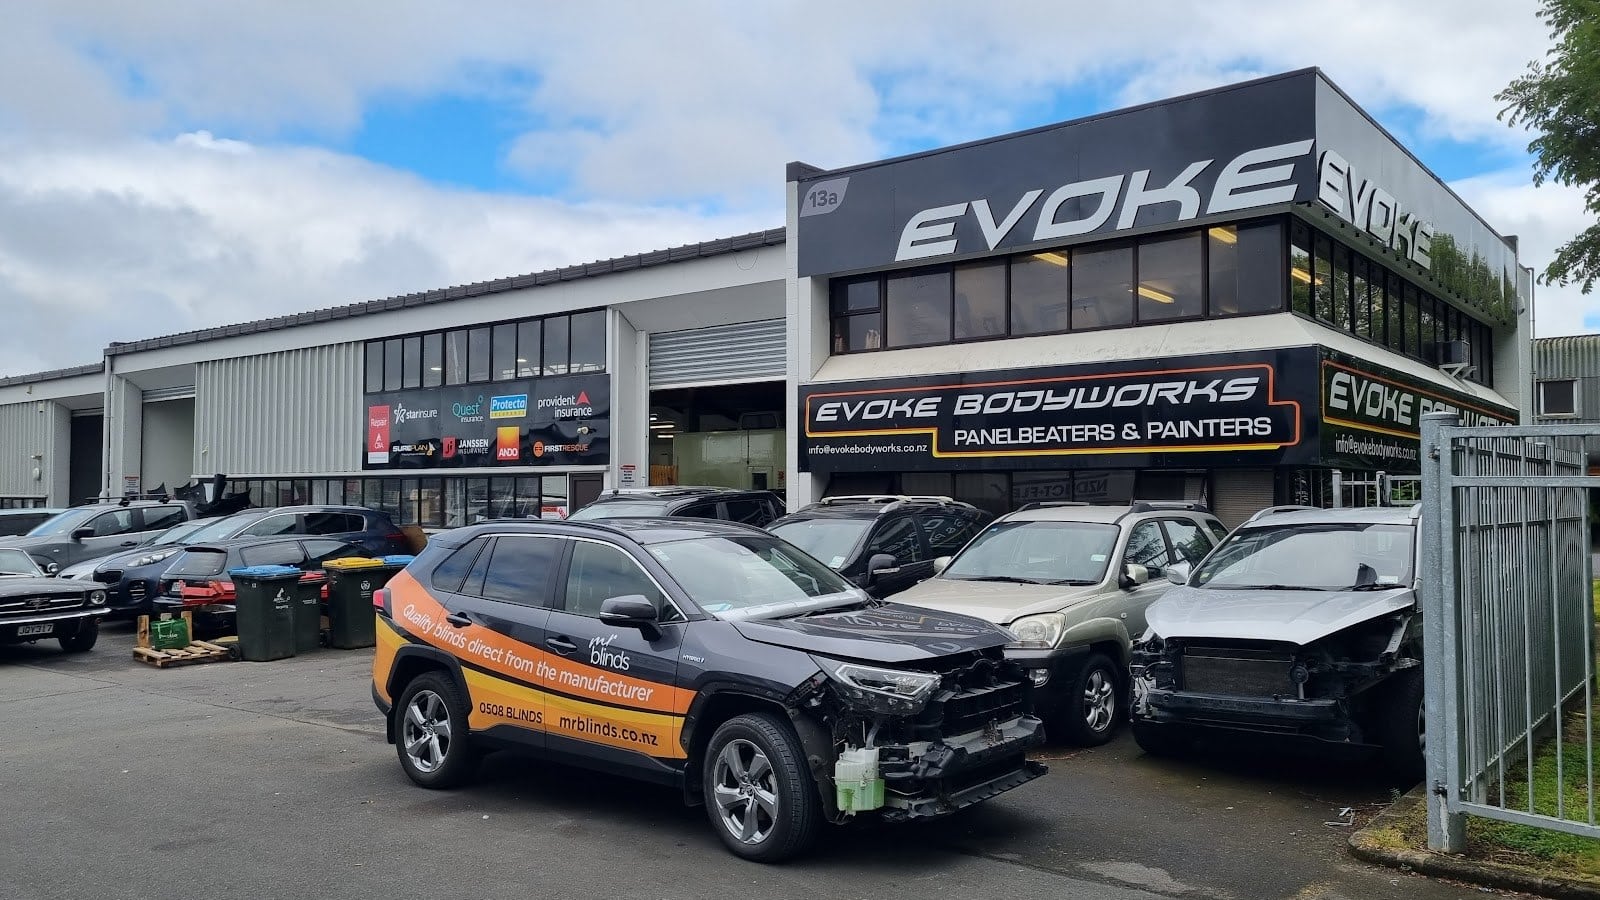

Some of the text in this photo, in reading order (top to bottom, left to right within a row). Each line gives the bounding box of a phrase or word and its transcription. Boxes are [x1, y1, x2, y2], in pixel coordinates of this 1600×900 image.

[808, 188, 838, 208] 13a
[895, 138, 1315, 261] EVOKE
[1318, 149, 1434, 270] EVOKE
[493, 398, 525, 410] Protecta
[538, 395, 576, 408] provident
[816, 376, 1260, 421] EVOKE BODYWORKS
[1330, 371, 1413, 425] EVOKE
[405, 409, 438, 419] starinsure
[452, 402, 481, 417] Quest
[554, 406, 593, 418] insurance
[954, 416, 1272, 446] PANELBEATERS & PAINTERS
[458, 439, 489, 449] JANSSEN
[498, 447, 518, 458] ANDO
[808, 443, 928, 457] info@evokebodyworks.co.nz
[1335, 432, 1417, 461] info@evokebodyworks.co.nz
[403, 604, 654, 702] Quality blinds direct from the manufacturer
[590, 647, 630, 671] blinds
[479, 702, 543, 724] 0508 BLINDS
[559, 715, 658, 747] mrblinds.co.nz
